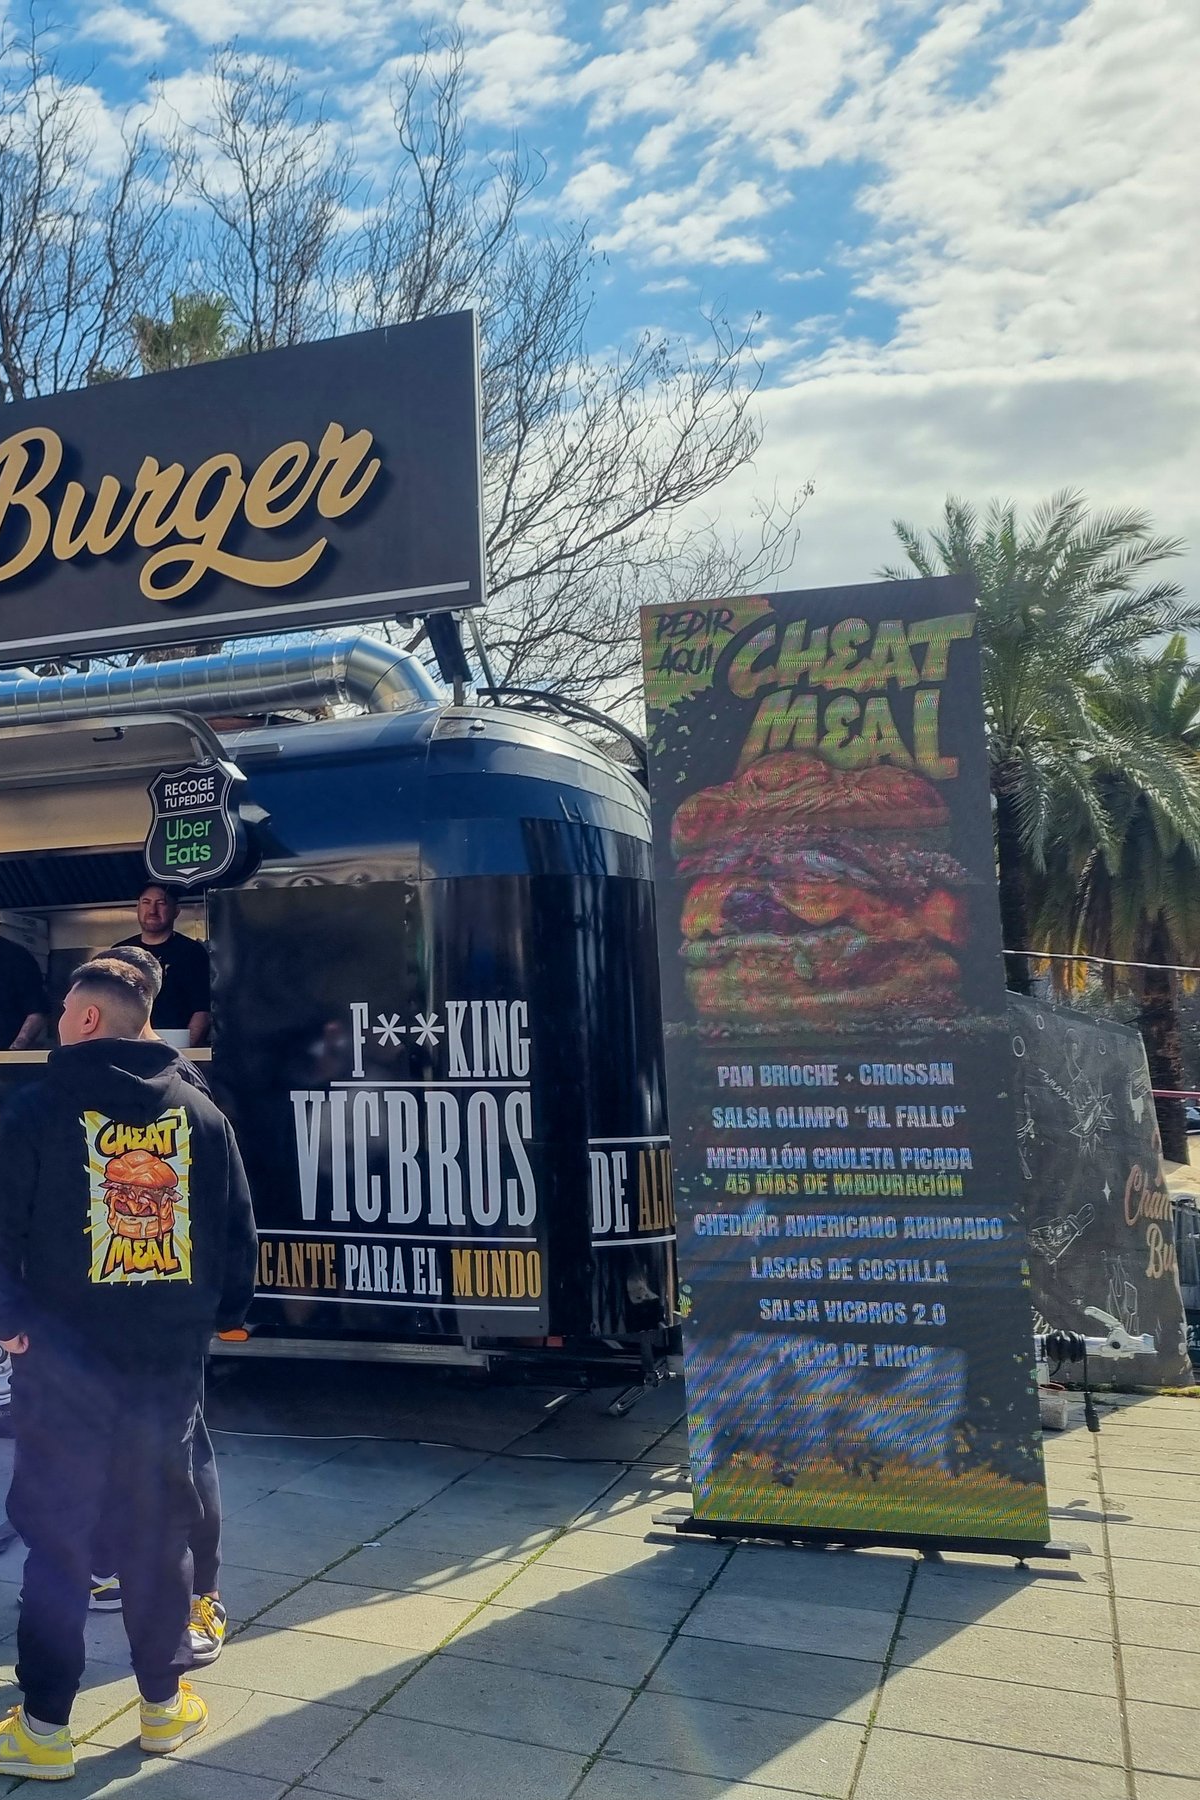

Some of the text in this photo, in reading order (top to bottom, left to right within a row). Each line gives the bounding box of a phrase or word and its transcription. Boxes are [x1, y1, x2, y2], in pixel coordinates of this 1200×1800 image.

[655, 607, 736, 643] PEDIR
[727, 612, 978, 699] CHEAT
[734, 689, 959, 780] MEAL
[164, 777, 215, 797] RECOGE
[164, 792, 215, 809] TU PEDIDO
[166, 819, 212, 841] Uber
[165, 842, 211, 865] Eats
[717, 1065, 754, 1087] PAN
[759, 1064, 839, 1087] BRIOCHE
[859, 1062, 954, 1086] CROISSAN
[711, 1106, 772, 1129] SALSA
[775, 1106, 849, 1128] OLIMPO
[100, 1117, 180, 1156] CHEAT
[290, 1090, 537, 1226] VICBROS
[706, 1142, 974, 1170] MEDALLÓN CHULETA PICADA
[589, 1151, 630, 1233] DE
[725, 1169, 963, 1197] 45 DÍAS DE MADURACIÓN
[694, 1214, 1004, 1240] CHEDDAR AMERICANO AHUMADO
[104, 1232, 180, 1275] MEAL
[255, 1242, 542, 1299] CANTE PARA EL MUNDO
[750, 1256, 949, 1283] LASCAS DE COSTILLA
[759, 1298, 948, 1326] SALSA VICBROS 2.0
[843, 1343, 868, 1367] DE
